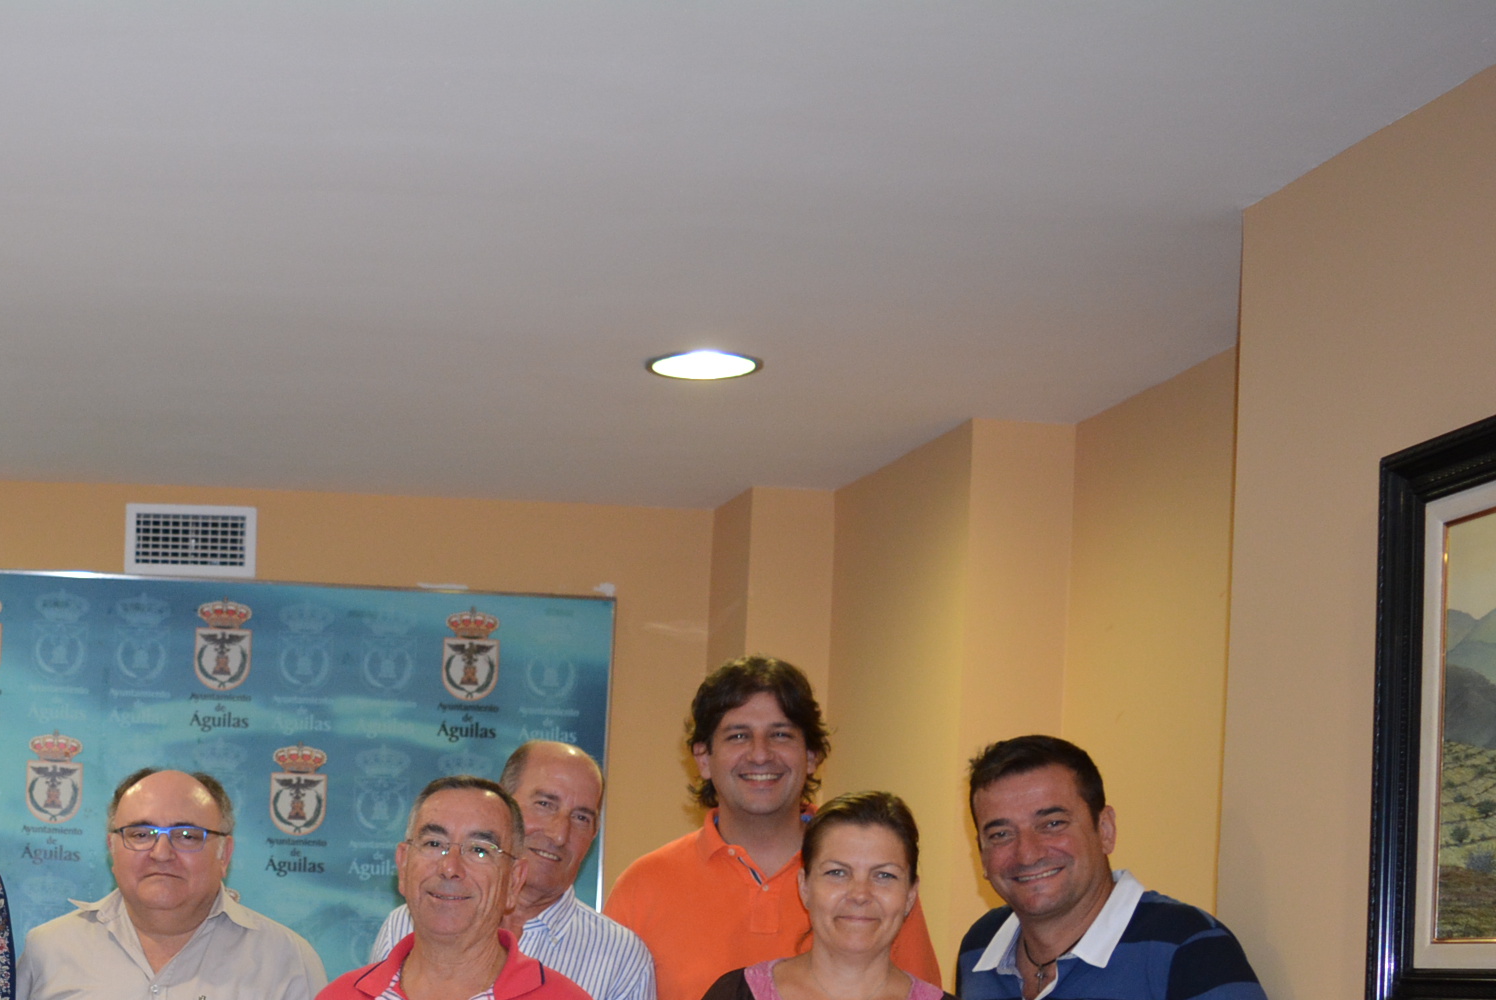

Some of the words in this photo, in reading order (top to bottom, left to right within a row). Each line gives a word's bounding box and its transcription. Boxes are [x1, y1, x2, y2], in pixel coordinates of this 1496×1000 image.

[189, 692, 251, 702] Ayuntamiento
[215, 703, 226, 712] de
[437, 703, 498, 713] Ayuntamiento
[189, 712, 249, 732] Águilas
[462, 713, 473, 722] de
[437, 722, 496, 743] Águilas
[22, 825, 82, 835] Ayuntamiento
[47, 836, 57, 845] de
[266, 837, 327, 847] Ayuntamiento
[20, 844, 80, 864] Águilas
[290, 848, 301, 857] de
[265, 857, 325, 877] Águilas
